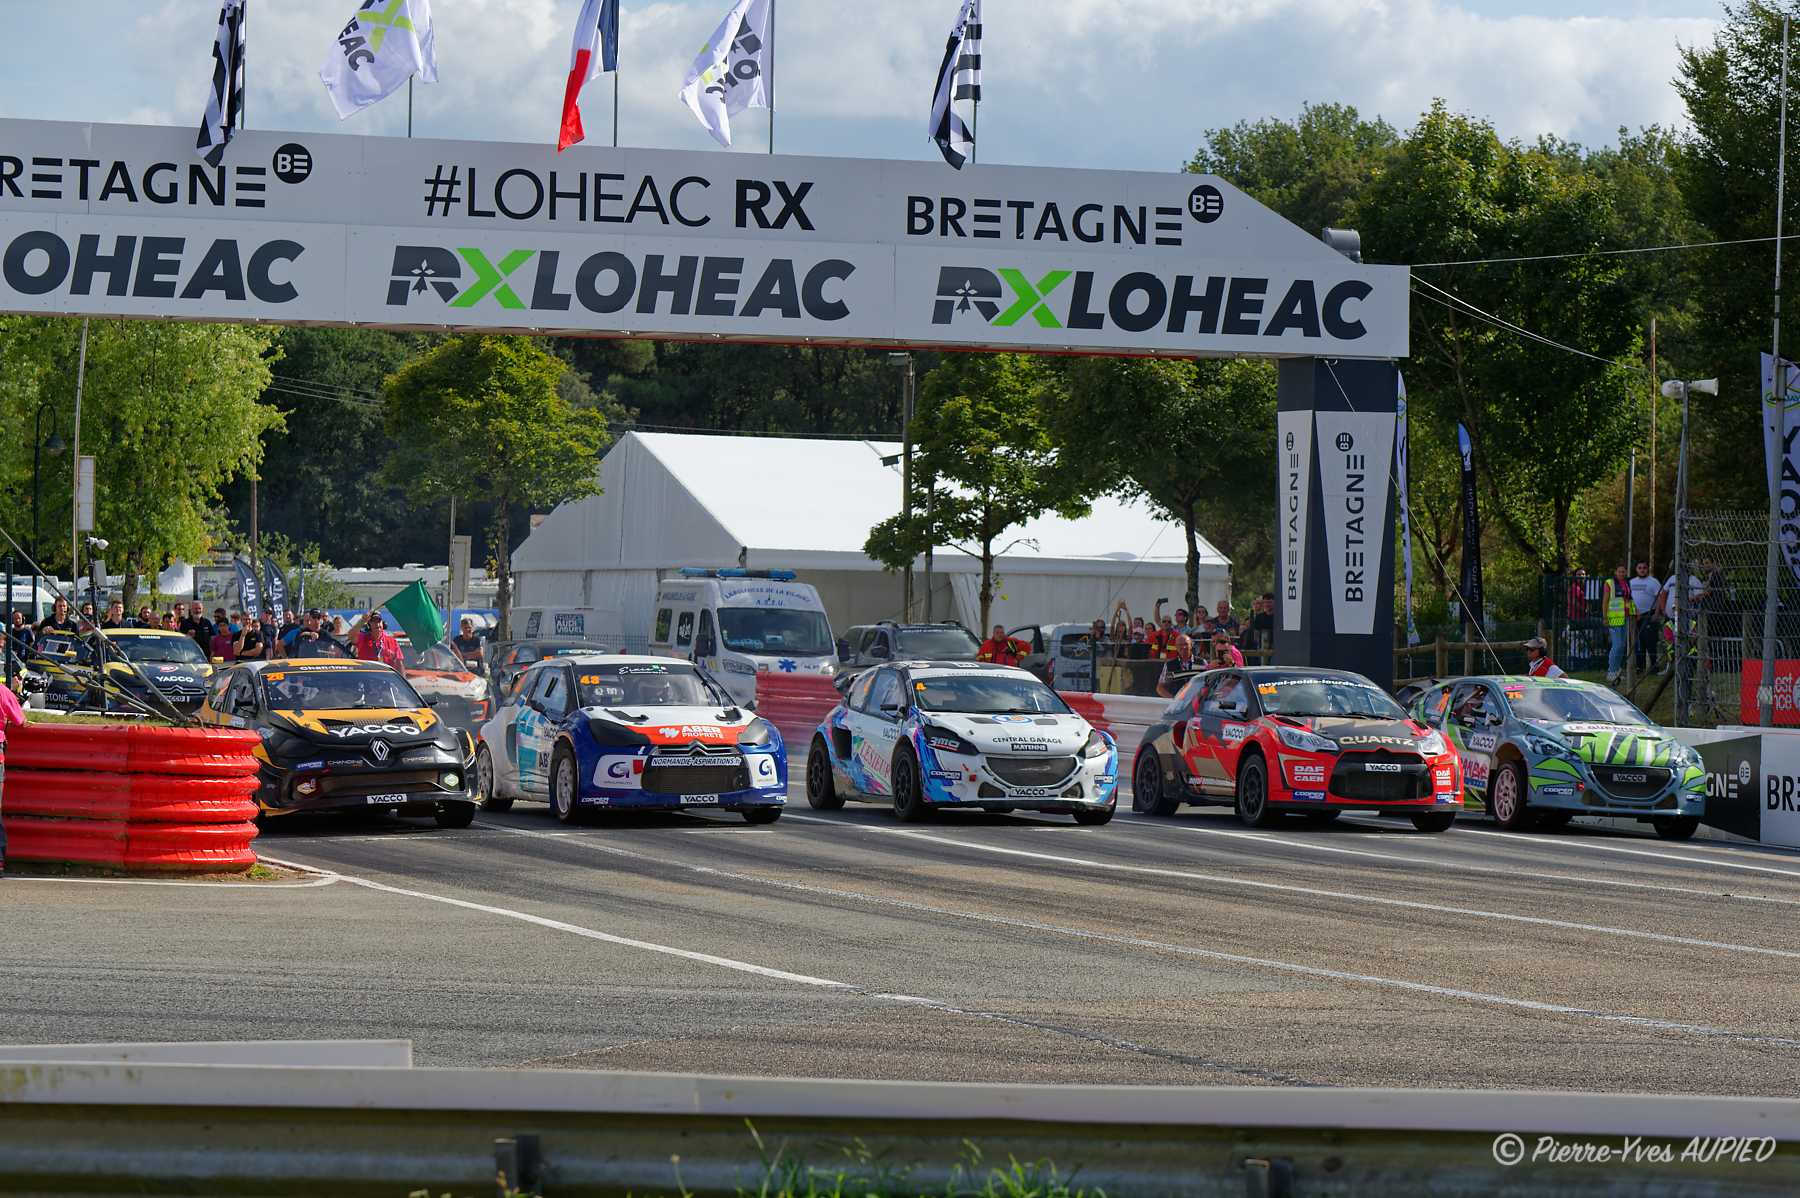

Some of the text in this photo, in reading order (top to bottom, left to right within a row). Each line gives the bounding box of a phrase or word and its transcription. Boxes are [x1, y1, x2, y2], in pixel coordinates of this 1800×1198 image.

[424, 165, 815, 231] #LOHEAC RX
[907, 196, 1182, 247] BRETAGNE
[3, 230, 306, 304] OHEAC
[1286, 453, 1299, 600] BRETAGNE
[1345, 454, 1365, 602] BRETAGNE
[329, 724, 420, 737] YACCO
[1340, 735, 1415, 746] QUARTZ
[1617, 774, 1643, 782] YACCO
[1015, 788, 1046, 796] YACCO
[371, 795, 404, 803] YACCO
[684, 795, 716, 803] YACCO
